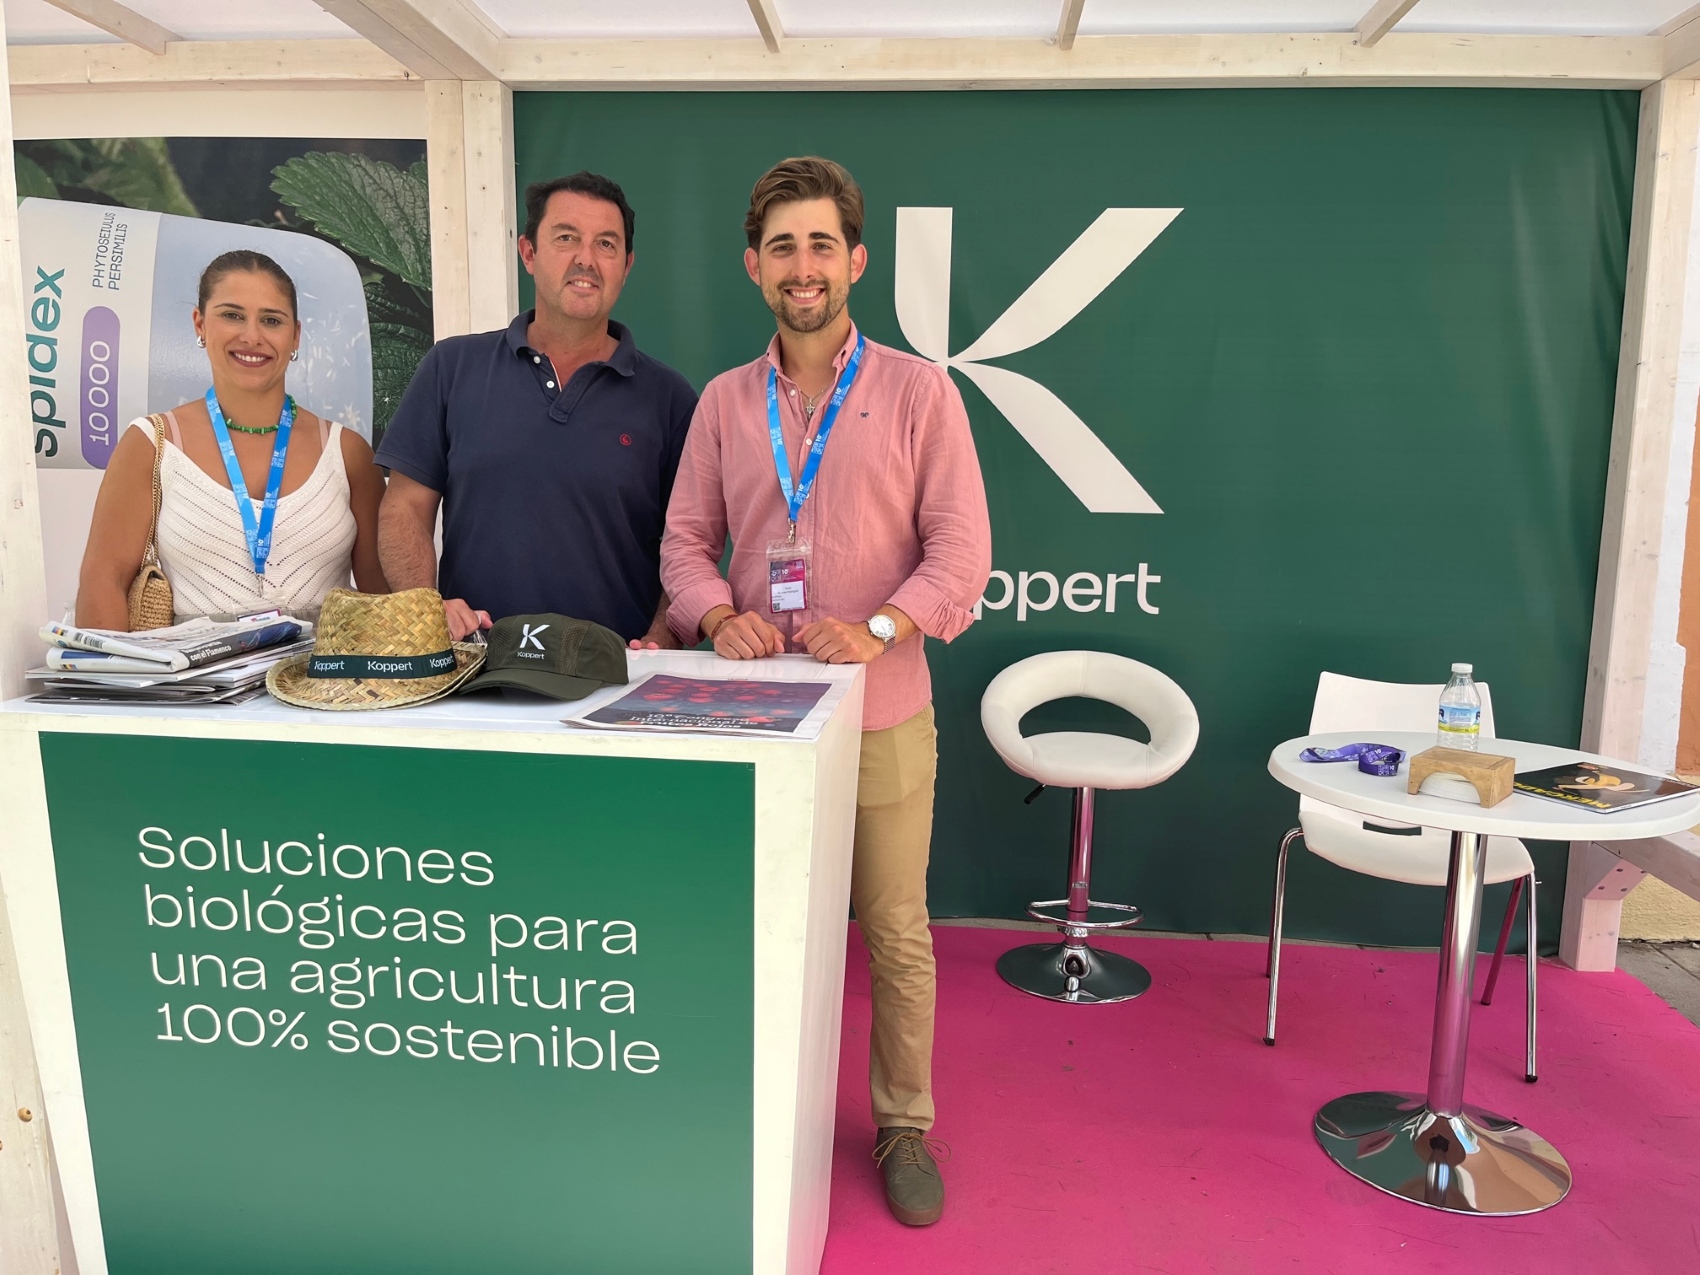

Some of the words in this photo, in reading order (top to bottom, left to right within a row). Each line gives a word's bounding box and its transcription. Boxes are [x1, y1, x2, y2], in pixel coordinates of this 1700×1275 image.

[92, 211, 116, 289] PHYTOSEIULUS
[108, 223, 128, 291] PERSIMILIS
[25, 265, 66, 458] spidex
[972, 562, 1162, 622] ppert
[205, 644, 232, 657] Flamenco
[367, 660, 413, 673] Koppert
[429, 655, 455, 669] Koppert
[517, 650, 545, 660] Koppert
[519, 623, 550, 650] K
[138, 826, 494, 886] Soluciones
[144, 884, 466, 950] biológicas
[490, 913, 637, 956] para
[151, 952, 267, 990] una
[290, 958, 637, 1014] agricultura
[157, 1002, 309, 1050] 100%
[327, 1021, 660, 1074] sostenible
